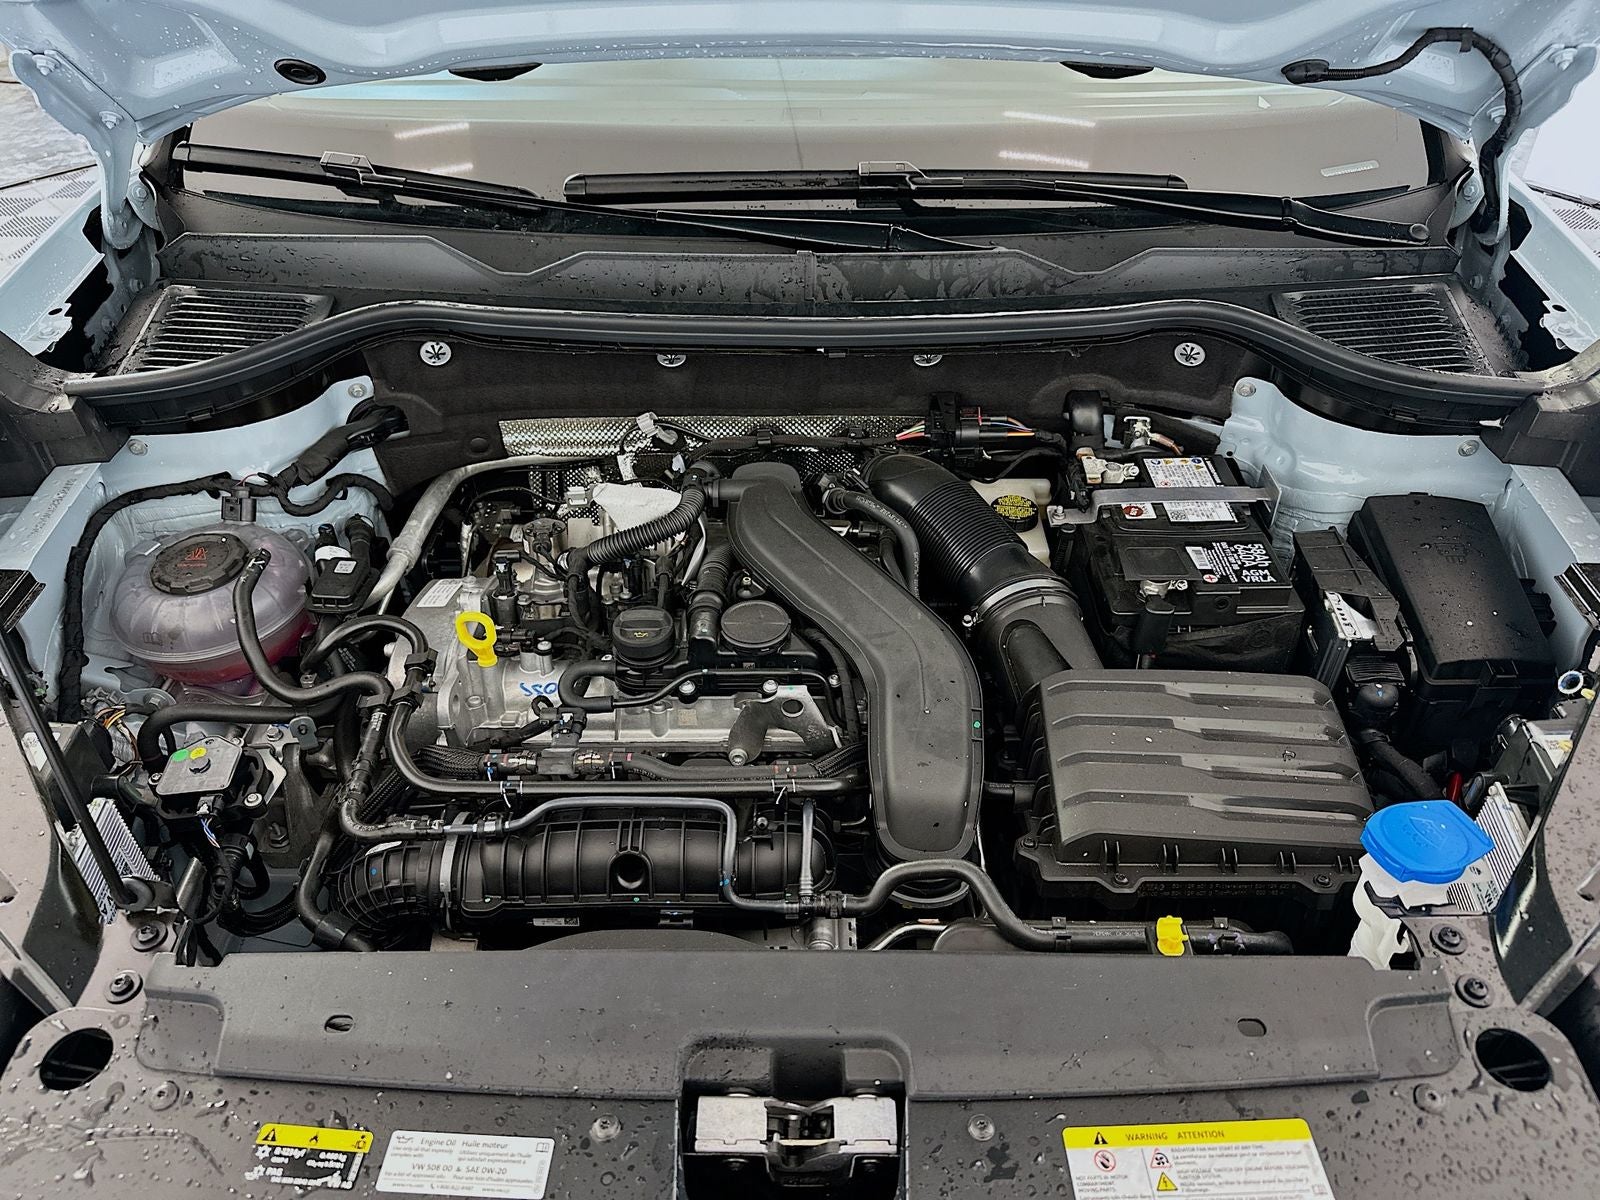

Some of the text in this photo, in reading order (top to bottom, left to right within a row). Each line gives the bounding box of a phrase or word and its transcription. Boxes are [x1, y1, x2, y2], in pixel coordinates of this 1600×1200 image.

[1125, 1130, 1225, 1141] WARNING ATTENTION
[420, 1138, 444, 1146] Engine
[462, 1140, 480, 1148] Huile
[412, 1163, 426, 1171] VW
[465, 1166, 480, 1174] SAE
